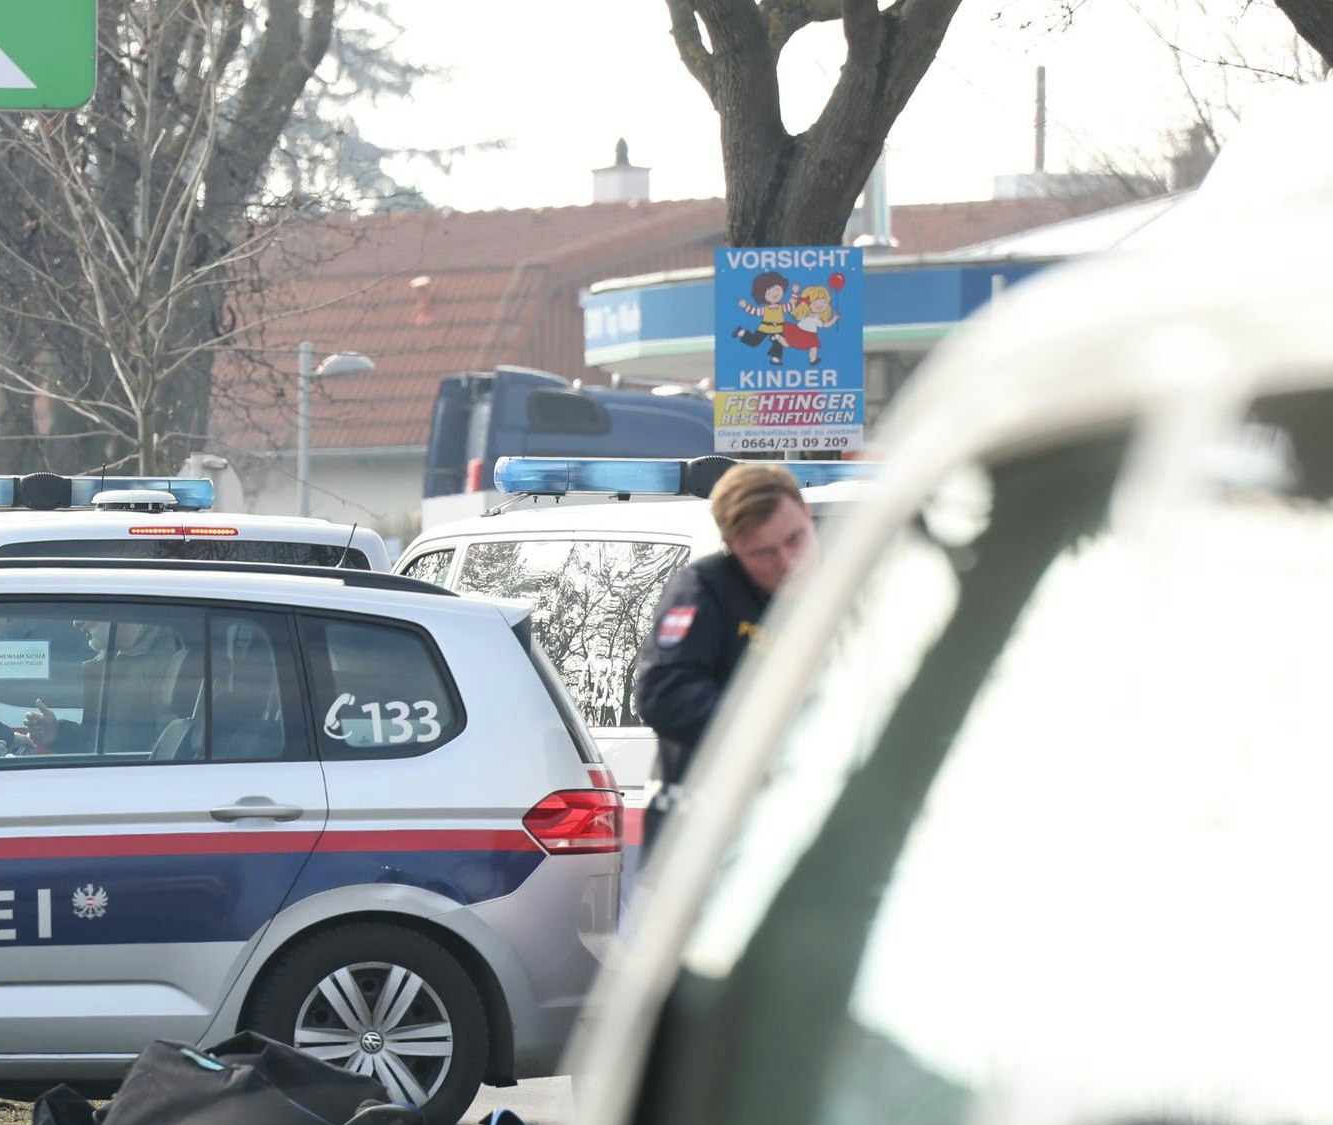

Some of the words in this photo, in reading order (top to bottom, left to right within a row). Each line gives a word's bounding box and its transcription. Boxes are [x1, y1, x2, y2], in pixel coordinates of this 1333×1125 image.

[726, 249, 851, 270] VORSICHT
[739, 369, 838, 389] KINDER
[741, 437, 798, 450] 0664/23
[802, 437, 819, 448] 09
[824, 436, 848, 448] 209
[361, 700, 442, 744] 133
